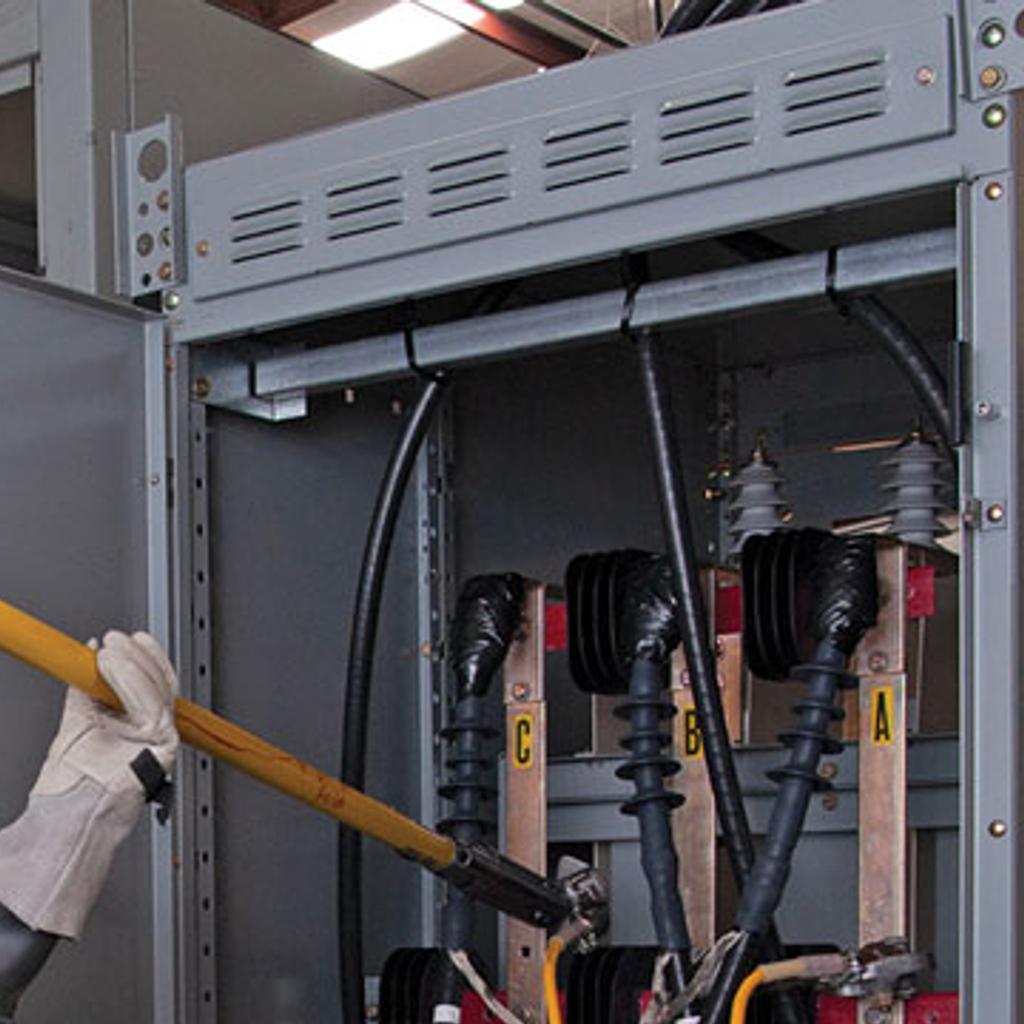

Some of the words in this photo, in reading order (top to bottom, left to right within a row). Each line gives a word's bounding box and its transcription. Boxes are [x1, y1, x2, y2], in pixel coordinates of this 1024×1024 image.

[685, 709, 702, 756] B
[873, 691, 891, 741] A
[516, 719, 531, 764] C
